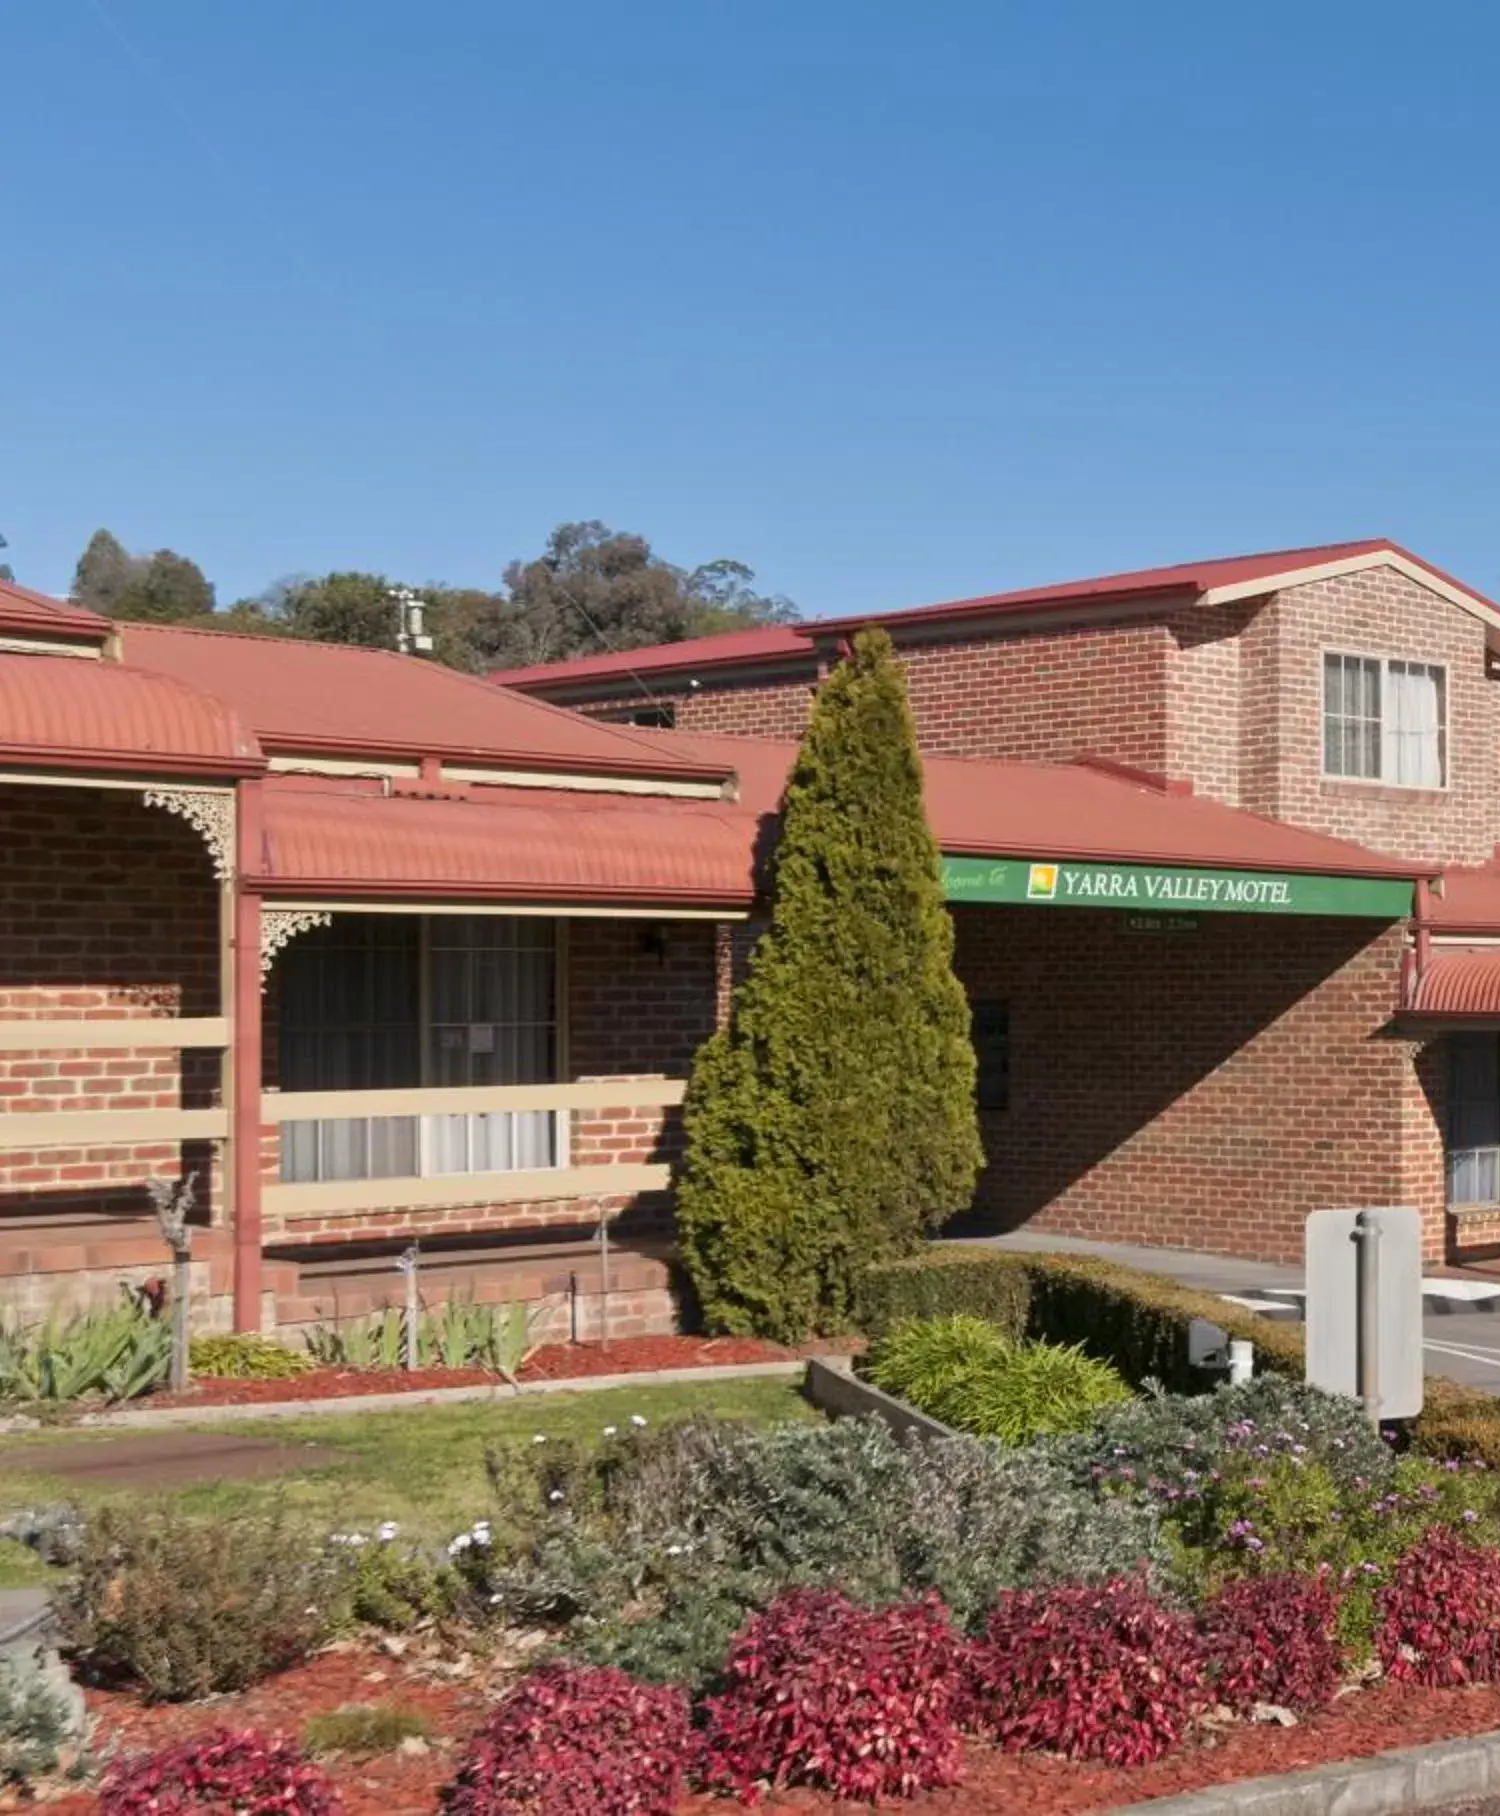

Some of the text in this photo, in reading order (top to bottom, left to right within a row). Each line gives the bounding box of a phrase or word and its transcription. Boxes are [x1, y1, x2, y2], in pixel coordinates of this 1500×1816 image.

[1063, 871, 1291, 904] YARRA VALLEY MOTEL
